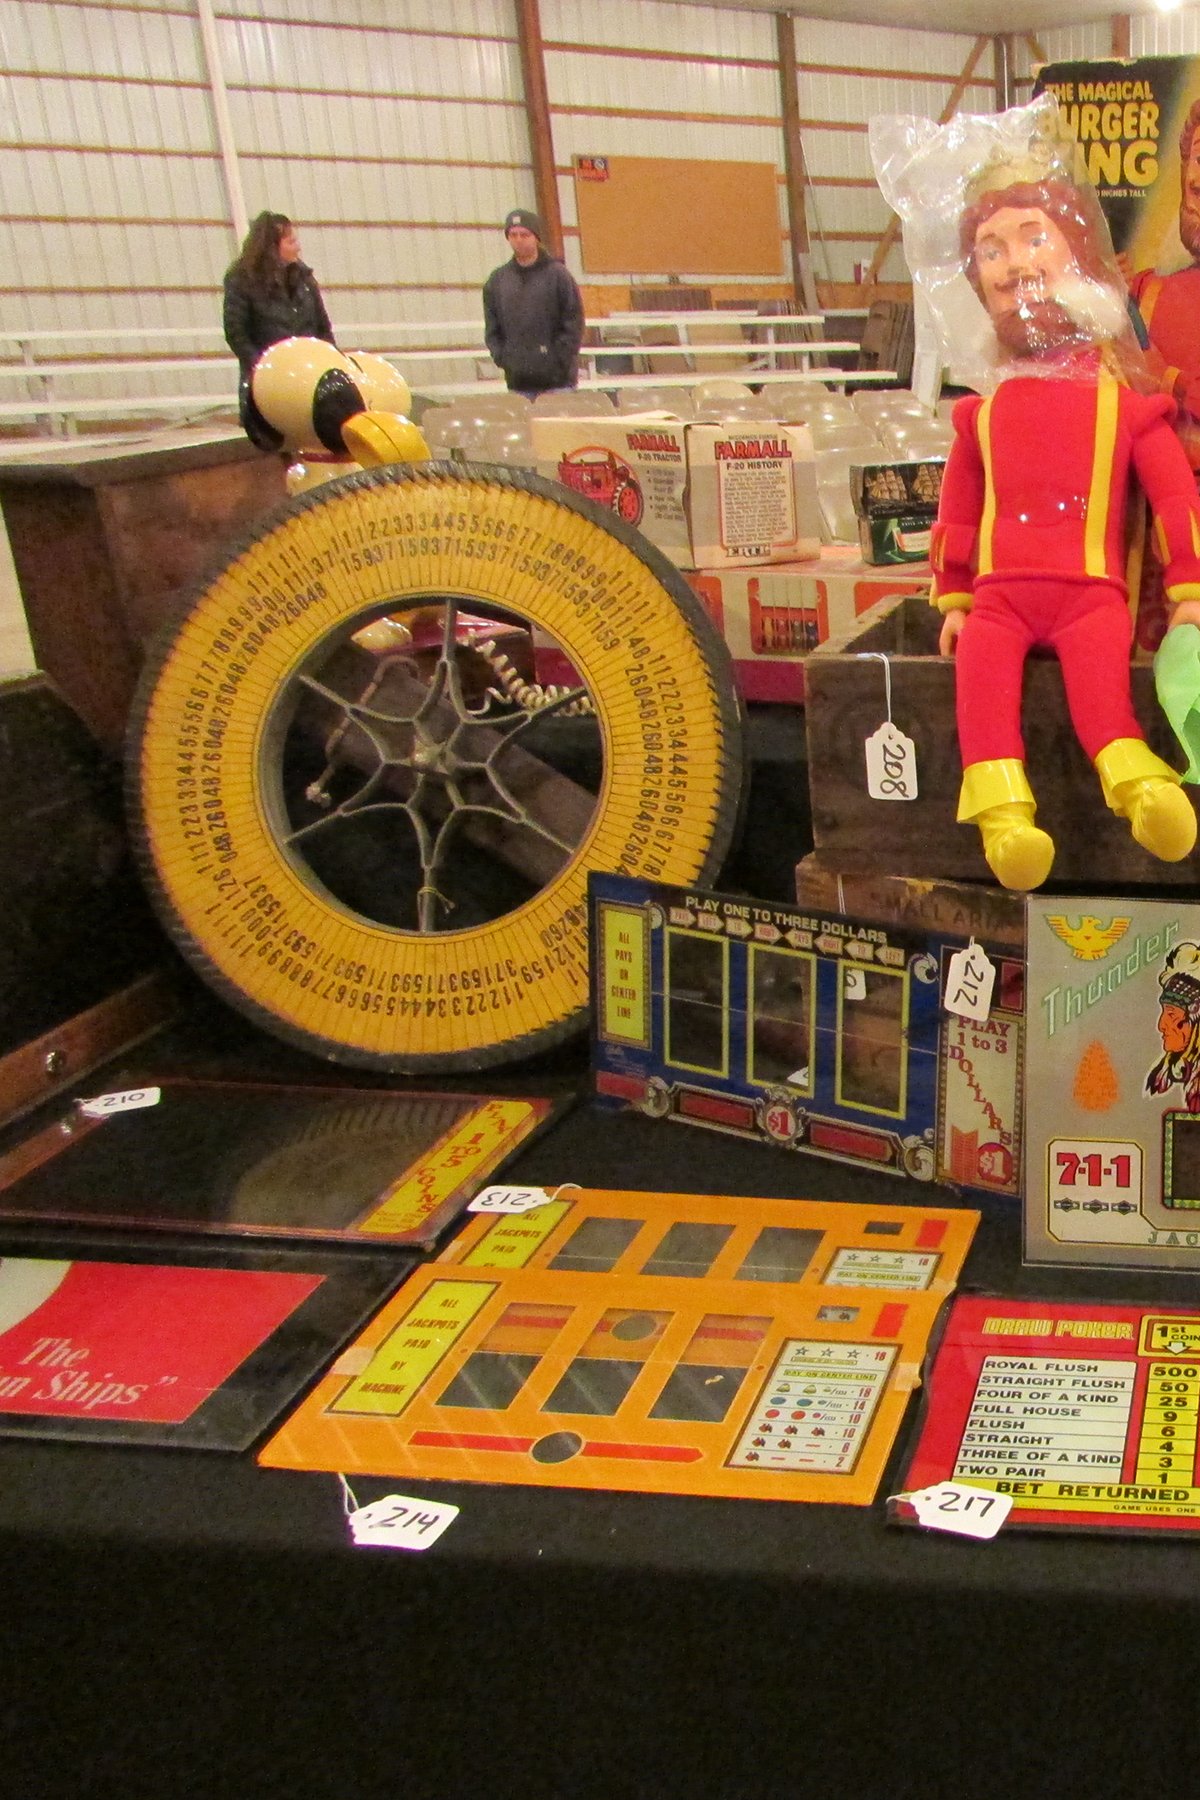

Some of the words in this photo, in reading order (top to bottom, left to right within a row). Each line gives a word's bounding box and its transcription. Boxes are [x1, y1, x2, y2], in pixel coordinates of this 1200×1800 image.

[1045, 82, 1074, 102] THE
[1078, 80, 1154, 101] MAGICAL
[1074, 140, 1159, 187] ING
[626, 434, 681, 452] FARMALL
[714, 440, 793, 460] FARMALL
[653, 454, 682, 462] TRACTOR
[726, 462, 746, 471] F-20
[747, 461, 784, 469] HISTORY
[881, 743, 909, 799] 208
[685, 895, 720, 913] PLAY
[723, 903, 750, 918] ONE
[752, 907, 771, 922] TO
[774, 913, 819, 932] THREE
[820, 920, 888, 944] DOLLARS
[618, 931, 630, 945] ALL
[615, 949, 633, 963] PAYS
[953, 960, 985, 1008] 212
[1042, 920, 1182, 1039] Thunder
[611, 985, 637, 1001] CENTER
[616, 1005, 631, 1020] LINE
[957, 1014, 1011, 1038] PLAY
[957, 1031, 966, 1046] 1
[972, 1034, 991, 1051] to
[995, 1038, 1009, 1054] 3
[103, 1093, 146, 1107] 210
[949, 1045, 1013, 1146] DOLLARS
[767, 1109, 791, 1136] $1
[979, 1149, 1006, 1179] $1
[481, 1191, 532, 1207] 213
[494, 1228, 542, 1239] JACKPOTS
[439, 1299, 459, 1309] ALL
[406, 1318, 460, 1331] JACKPOTS
[982, 1317, 1053, 1336] DRAW
[1055, 1320, 1135, 1340] POKER
[1156, 1325, 1187, 1340] 1st
[402, 1339, 431, 1349] PAID
[17, 1337, 91, 1368] The
[874, 1351, 887, 1362] 18
[389, 1360, 407, 1371] BY
[985, 1360, 1038, 1371] ROYAL
[1045, 1362, 1099, 1373] FLUSH
[1153, 1366, 1198, 1378] 500
[357, 1382, 407, 1395] MACHINE
[981, 1375, 1066, 1388] STRAIGHT
[1071, 1379, 1127, 1390] FLUSH
[1159, 1382, 1189, 1393] 50
[858, 1387, 872, 1398] 18
[976, 1389, 1022, 1400] FOUR
[1028, 1391, 1051, 1401] OF
[1057, 1392, 1070, 1401] A
[1076, 1393, 1119, 1404] KIND
[1159, 1396, 1188, 1407] 25
[852, 1400, 866, 1411] 14
[972, 1404, 1015, 1414] FULL
[1023, 1406, 1082, 1417] HOUSE
[848, 1414, 862, 1425] 10
[968, 1419, 1025, 1430] FLUSH
[965, 1433, 1054, 1445] STRAIGHT
[961, 1449, 1019, 1460] THREE
[1026, 1451, 1050, 1461] OF
[1057, 1452, 1069, 1462] A
[1077, 1453, 1122, 1465] KIND
[957, 1464, 998, 1475] TWO
[1005, 1466, 1046, 1478] PAIR
[995, 1481, 1044, 1495] BET
[1058, 1484, 1190, 1502] RETURNED
[938, 1491, 996, 1518] 217
[369, 1506, 440, 1535] 214
